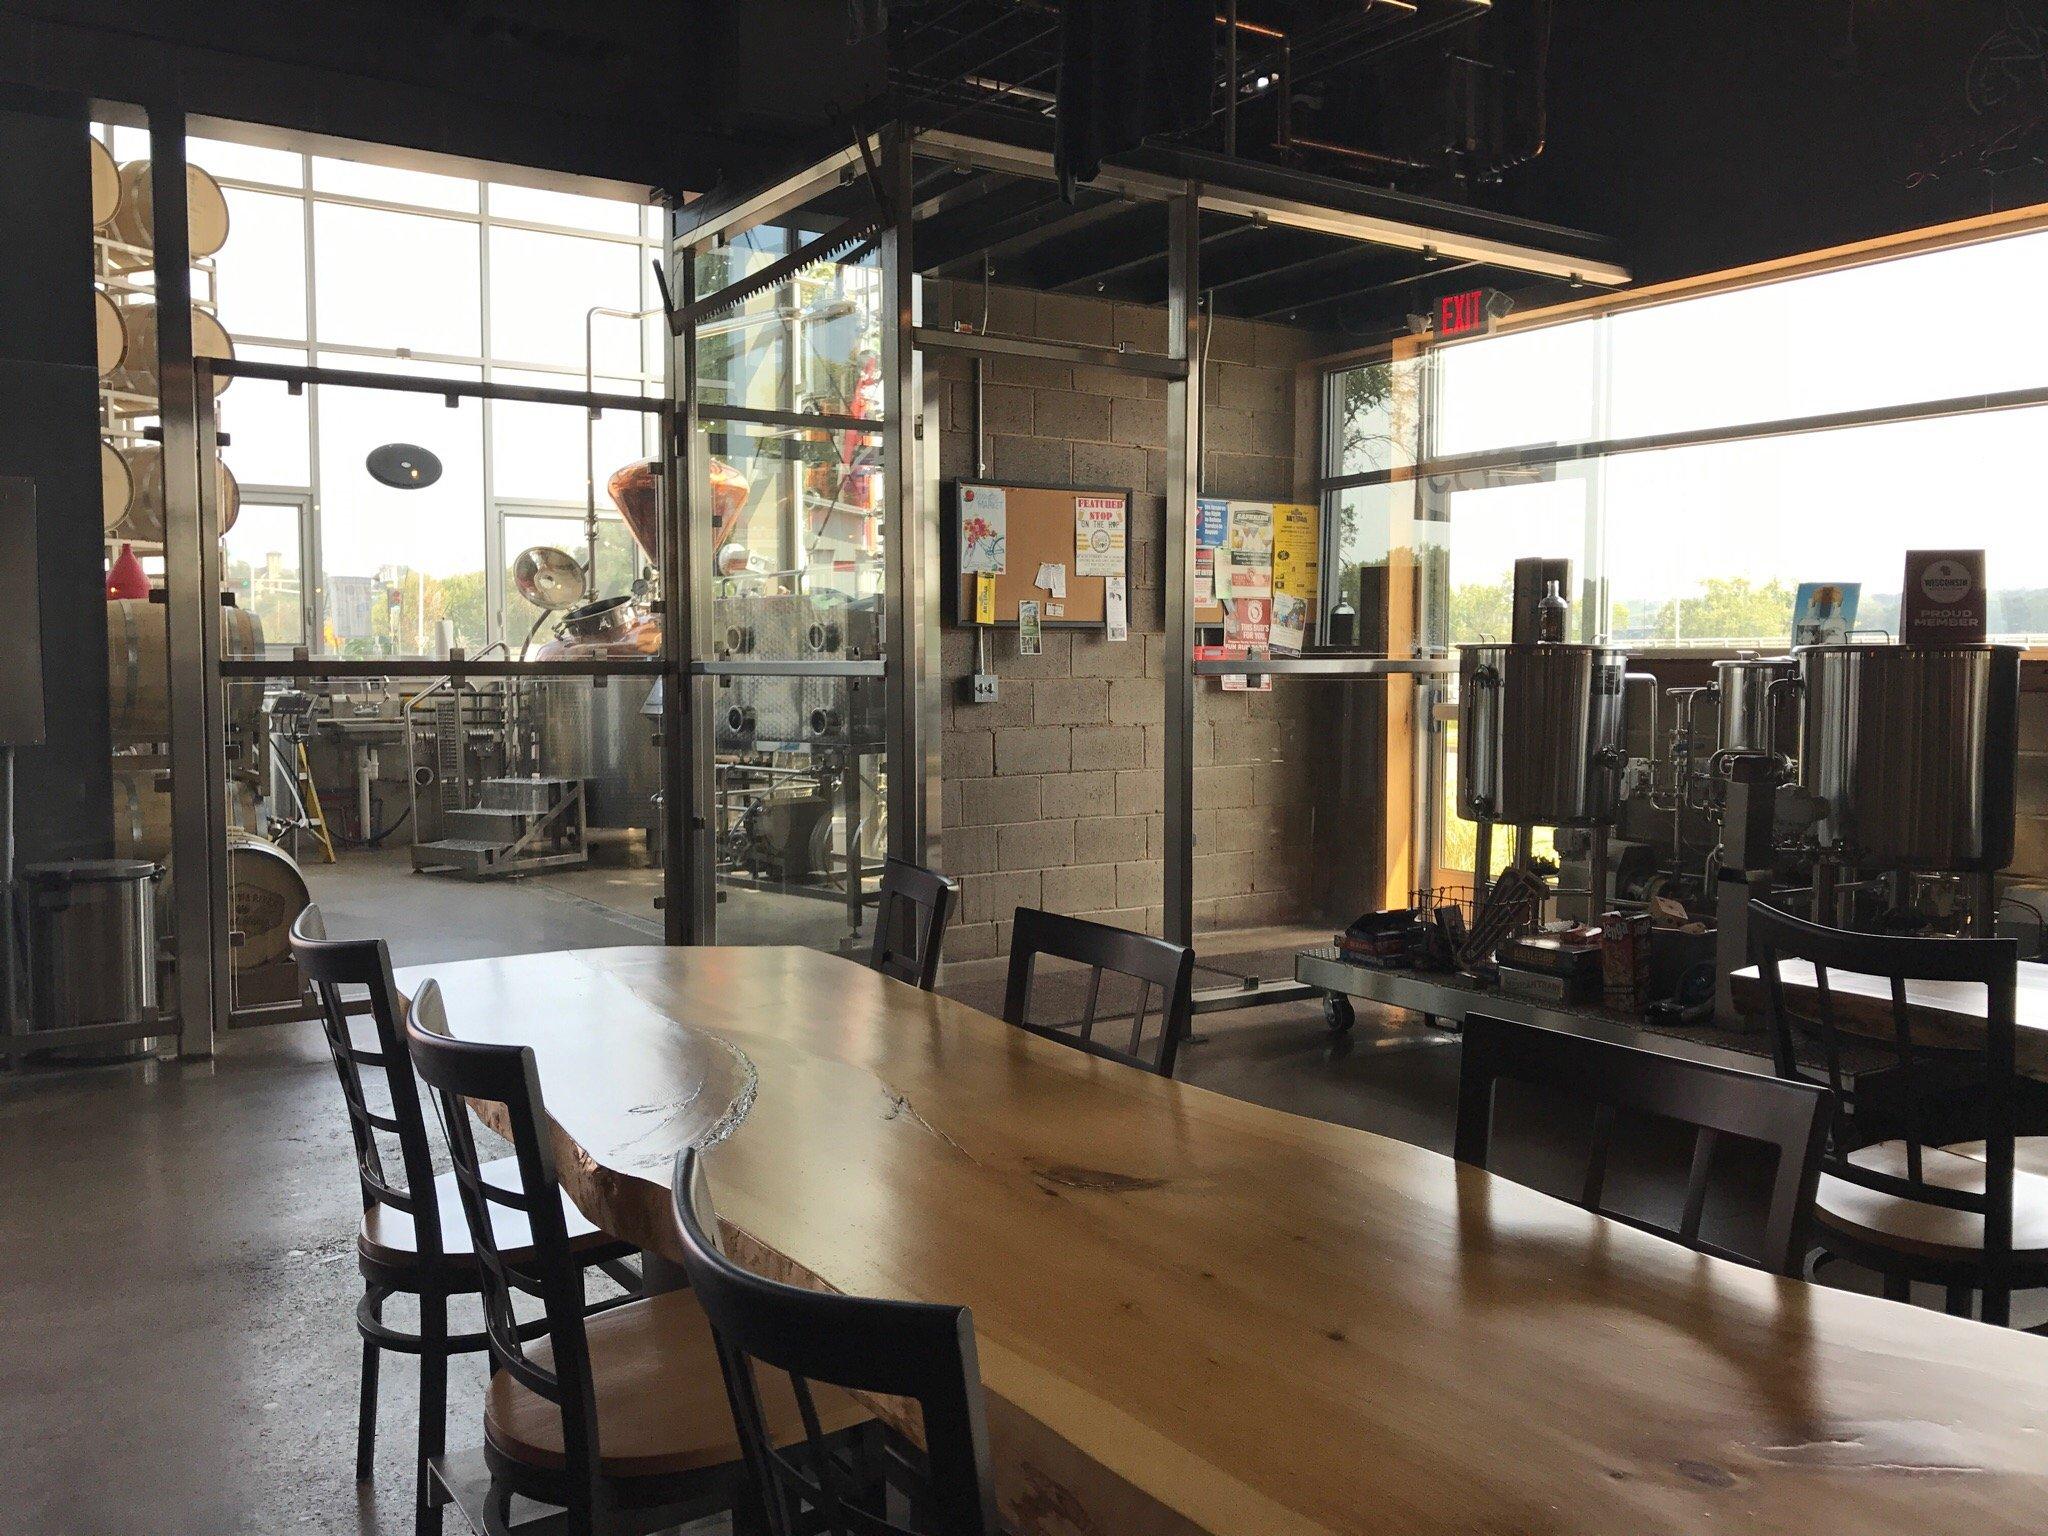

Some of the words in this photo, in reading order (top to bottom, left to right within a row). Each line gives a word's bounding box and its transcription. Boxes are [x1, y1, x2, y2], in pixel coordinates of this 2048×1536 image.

[1442, 290, 1483, 336] EXIT
[1078, 499, 1123, 509] FEATURED
[1090, 511, 1113, 520] STOP
[1081, 519, 1090, 527] ON
[1094, 520, 1105, 528] THE
[1924, 578, 1968, 588] WISCONSIN
[1921, 609, 1973, 618] PROUD
[1914, 618, 1980, 627] MEMBER
[1241, 623, 1253, 632] THIS
[1243, 632, 1254, 640] FOR
